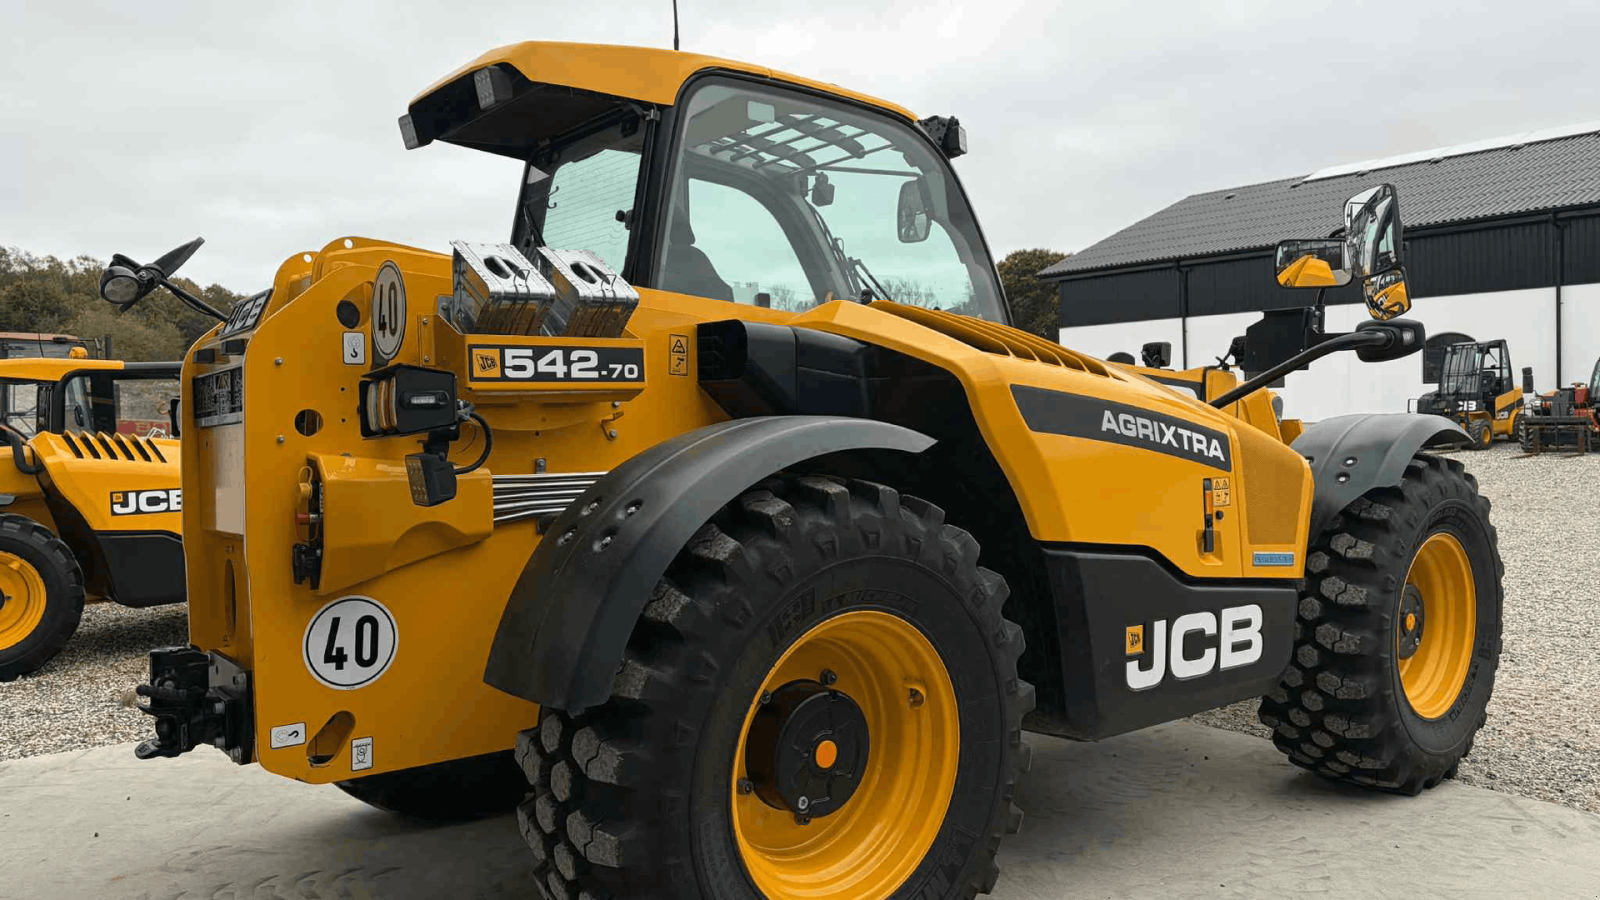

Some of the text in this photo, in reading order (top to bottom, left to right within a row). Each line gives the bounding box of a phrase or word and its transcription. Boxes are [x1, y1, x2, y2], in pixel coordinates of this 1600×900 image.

[378, 281, 398, 339] 40
[504, 348, 639, 379] 542-70
[1101, 409, 1226, 462] AGRIXTRA
[323, 614, 379, 671] 40
[1126, 604, 1263, 691] JCB
